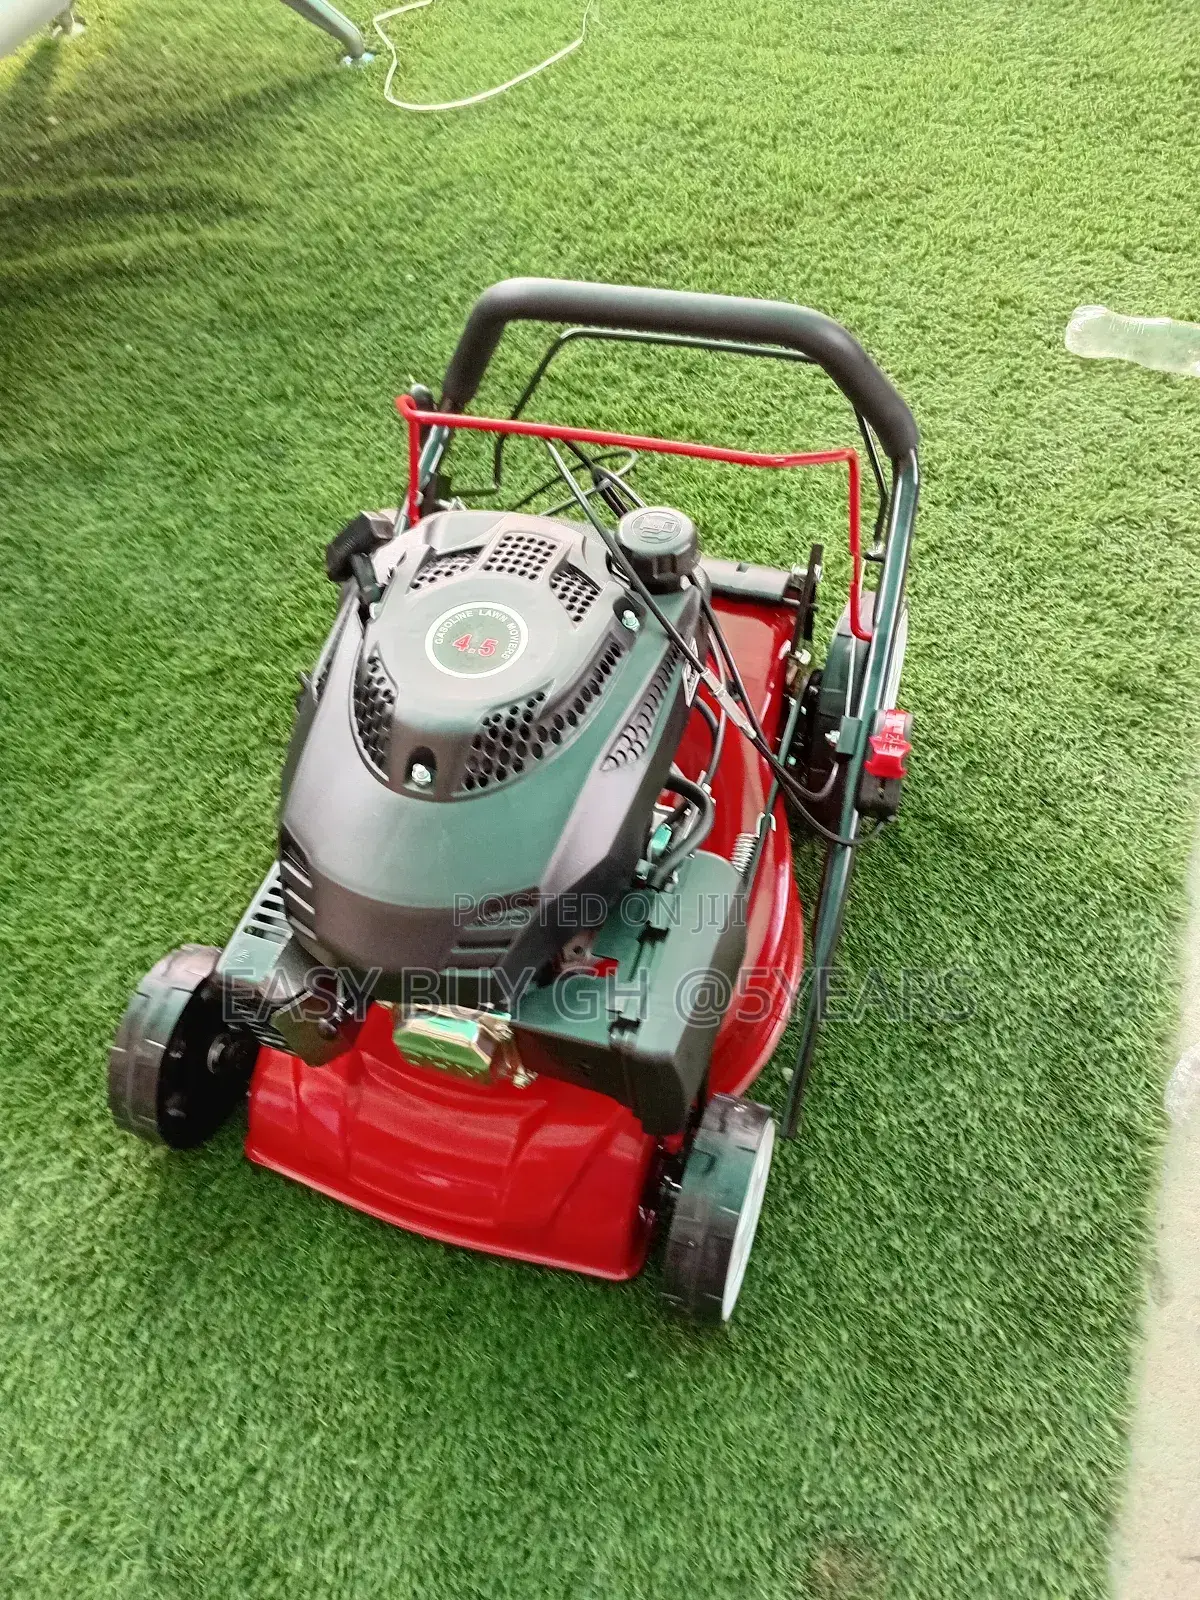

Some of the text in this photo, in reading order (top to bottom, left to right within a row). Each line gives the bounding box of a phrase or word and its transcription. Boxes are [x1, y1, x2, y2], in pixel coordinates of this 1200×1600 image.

[434, 610, 473, 645] GASOLINE
[478, 609, 508, 623] LAWN
[452, 633, 499, 657] 4.5
